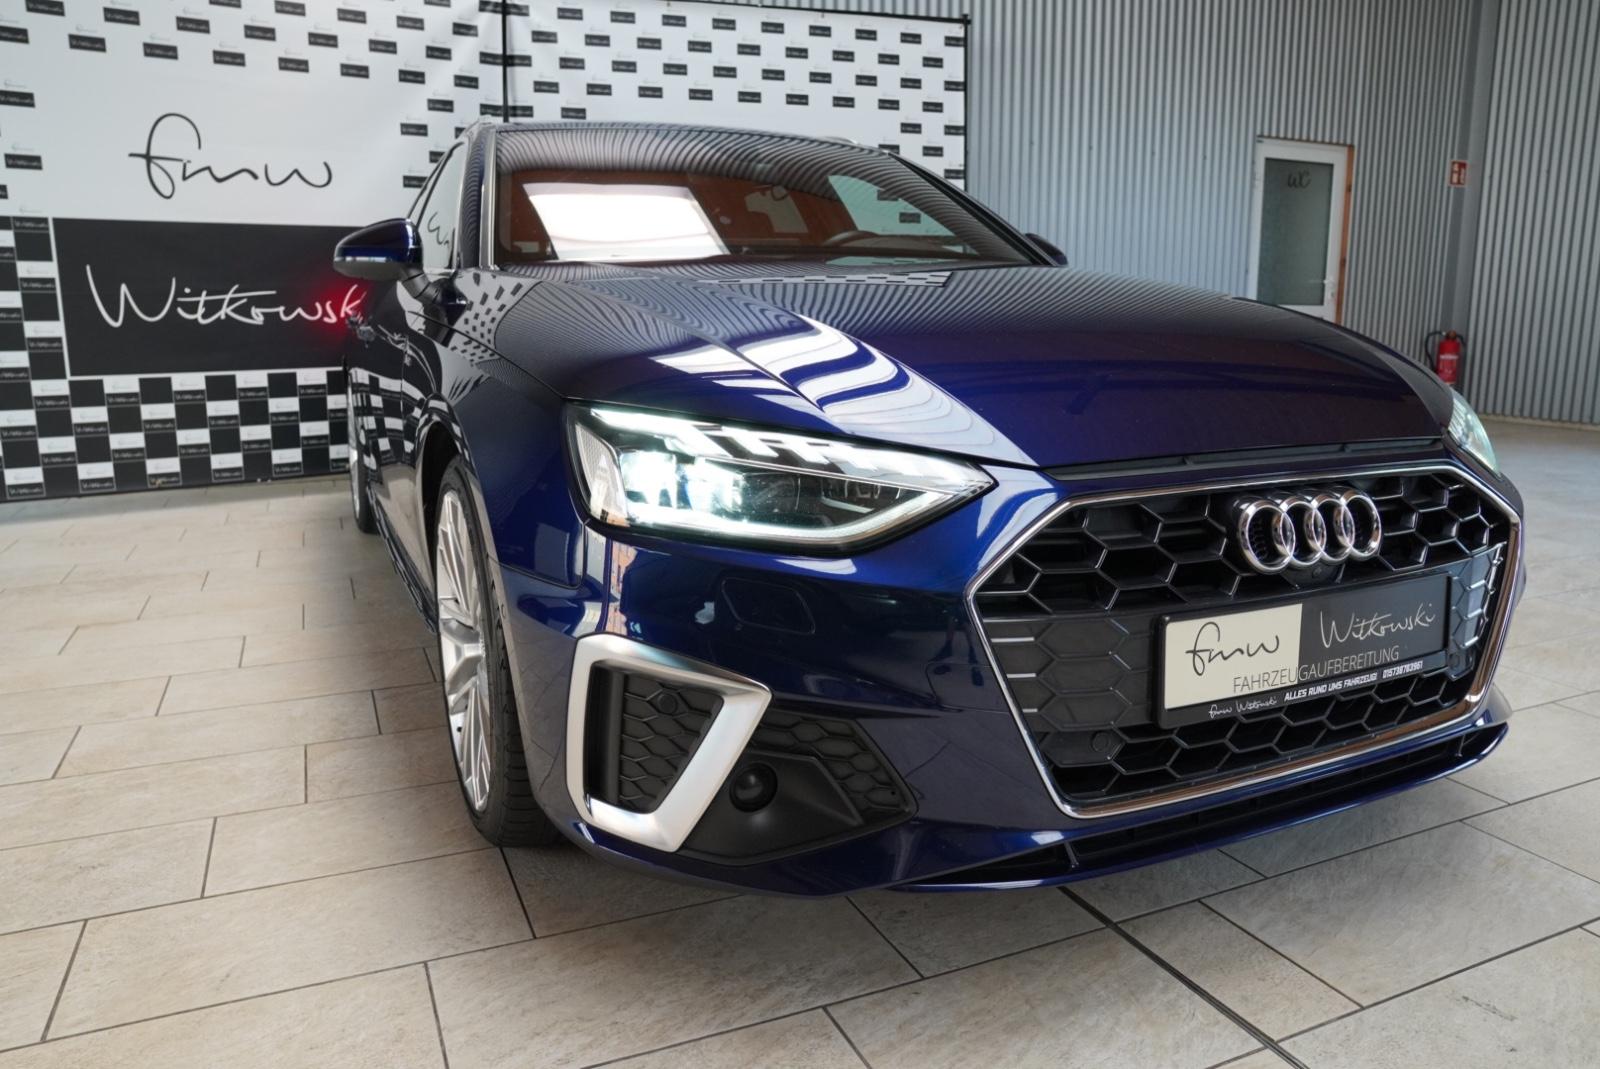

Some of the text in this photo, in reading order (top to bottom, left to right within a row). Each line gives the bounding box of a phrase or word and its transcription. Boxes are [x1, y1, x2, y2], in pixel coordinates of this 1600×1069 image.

[86, 264, 364, 327] Witkowsk
[1320, 603, 1436, 648] Witkowski
[1233, 645, 1399, 693] FAHRZEUGAUFBEREITUNG
[1284, 689, 1307, 701] ALLES
[1308, 684, 1327, 696] RUND
[1328, 680, 1343, 692] UMS
